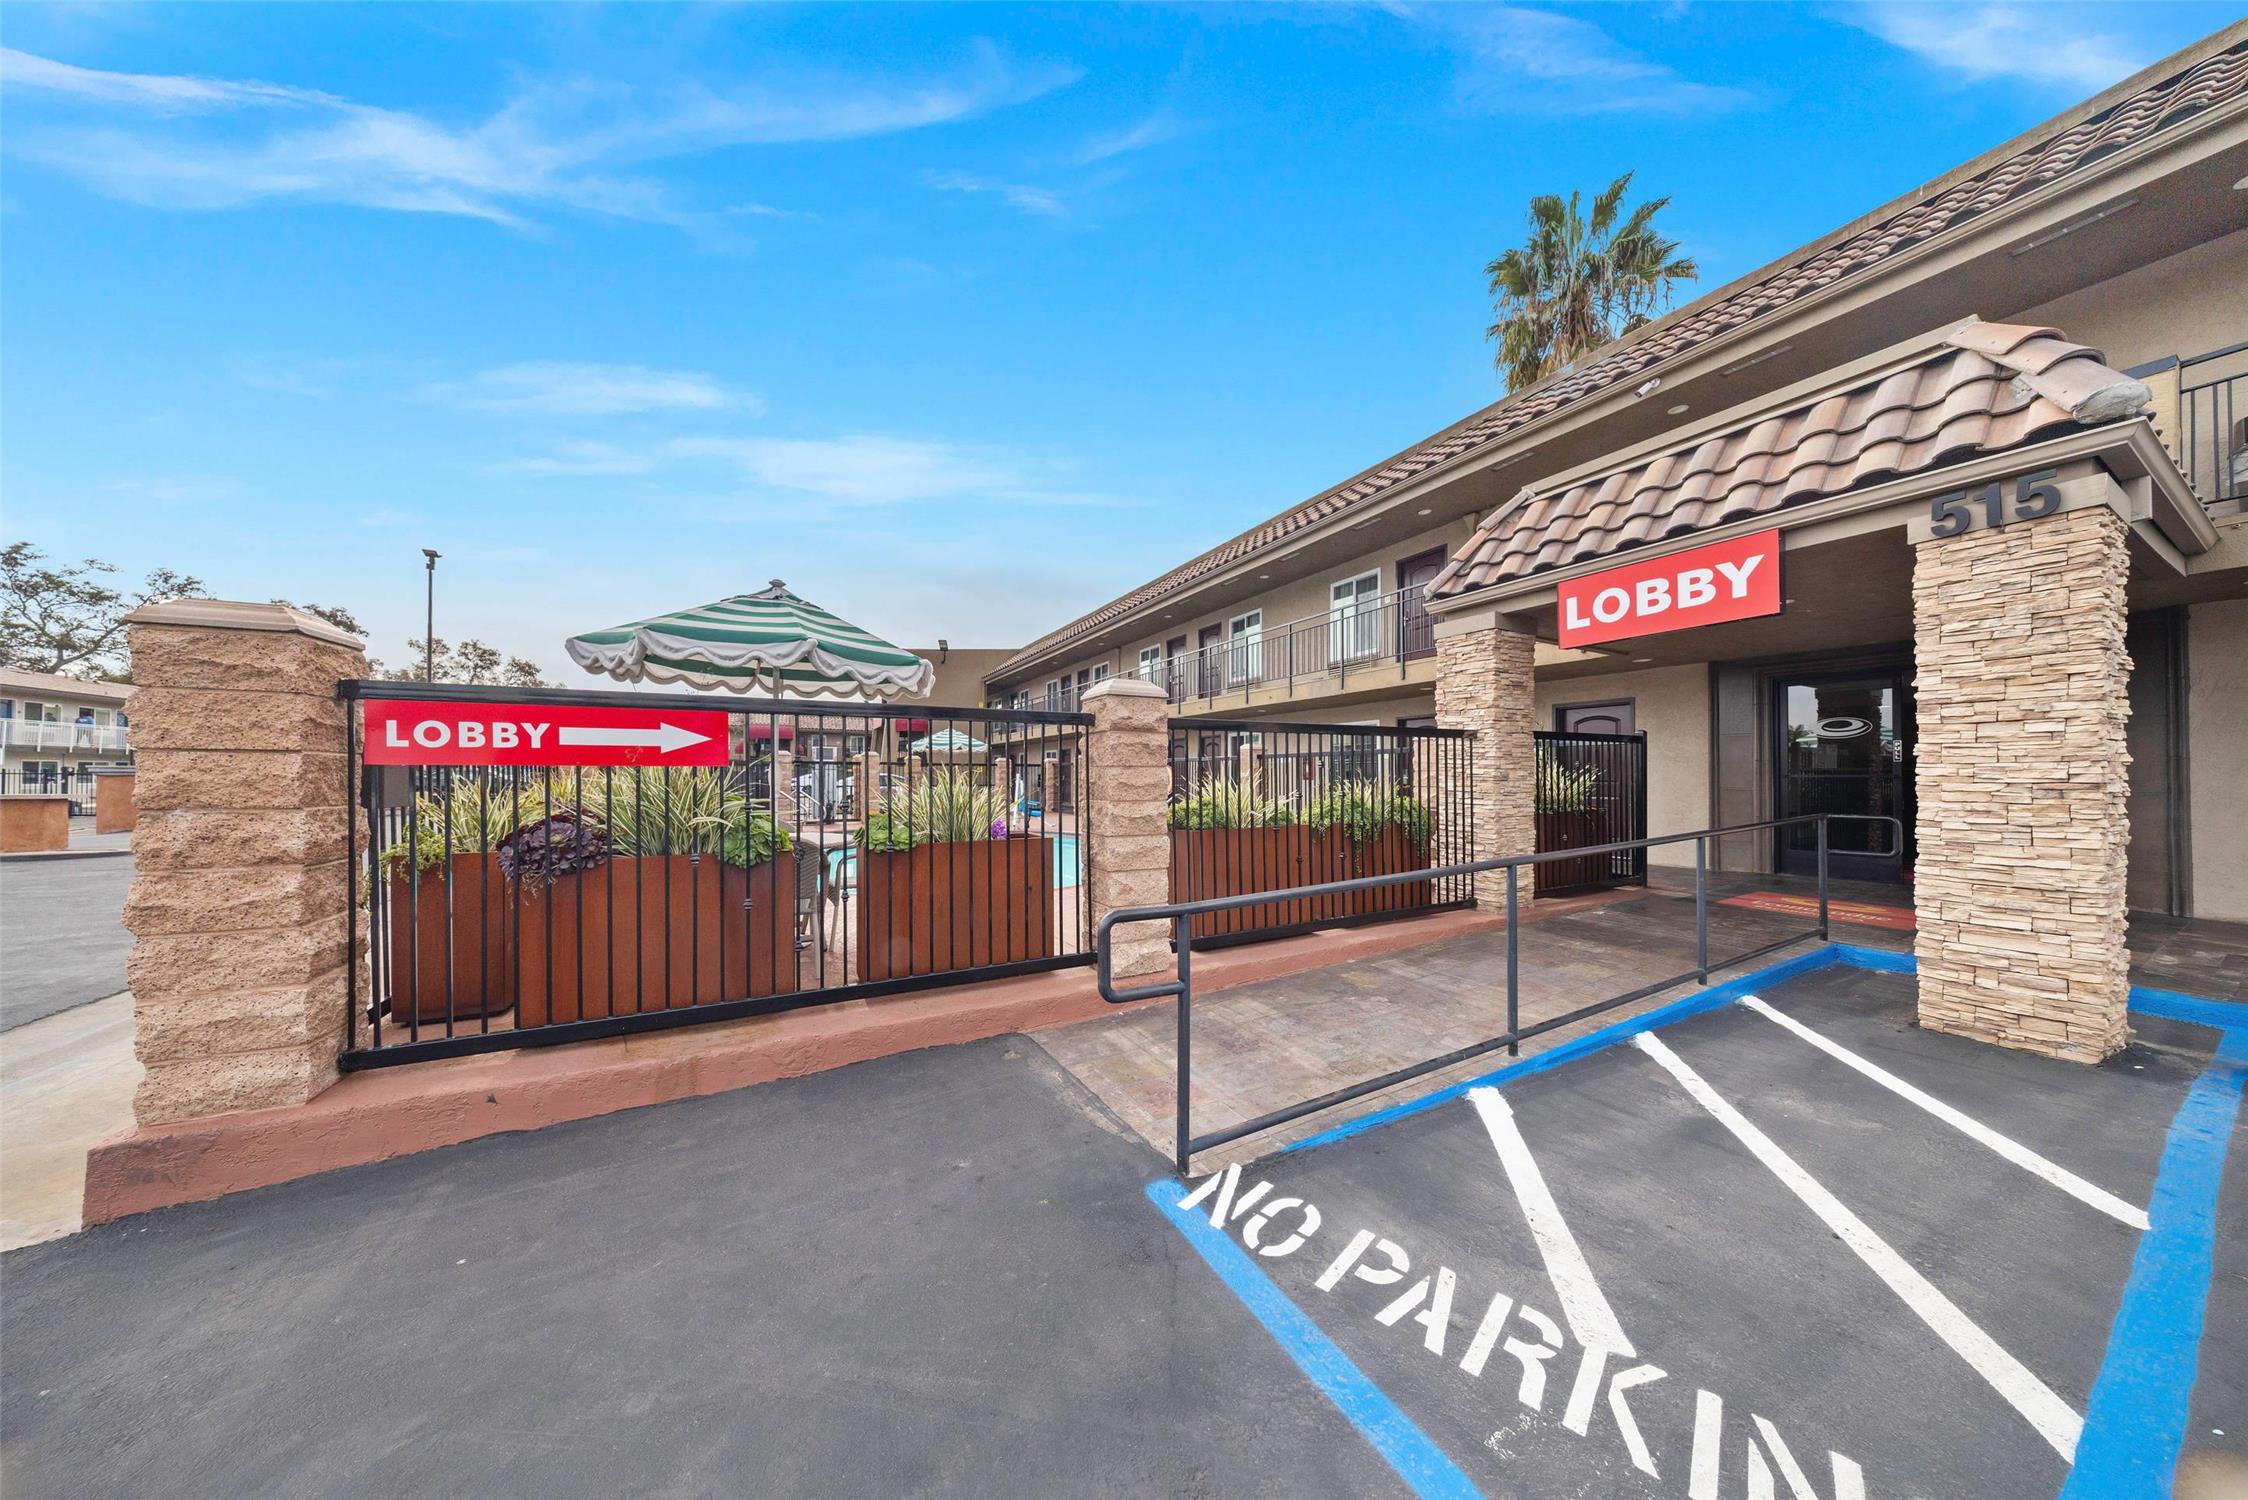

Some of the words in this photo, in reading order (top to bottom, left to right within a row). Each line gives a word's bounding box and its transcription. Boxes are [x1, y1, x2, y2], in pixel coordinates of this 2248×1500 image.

[1931, 468, 2061, 538] 515
[1566, 553, 1765, 630] LOBBY
[385, 719, 550, 749] LOBBY
[1177, 1161, 1323, 1258] NO
